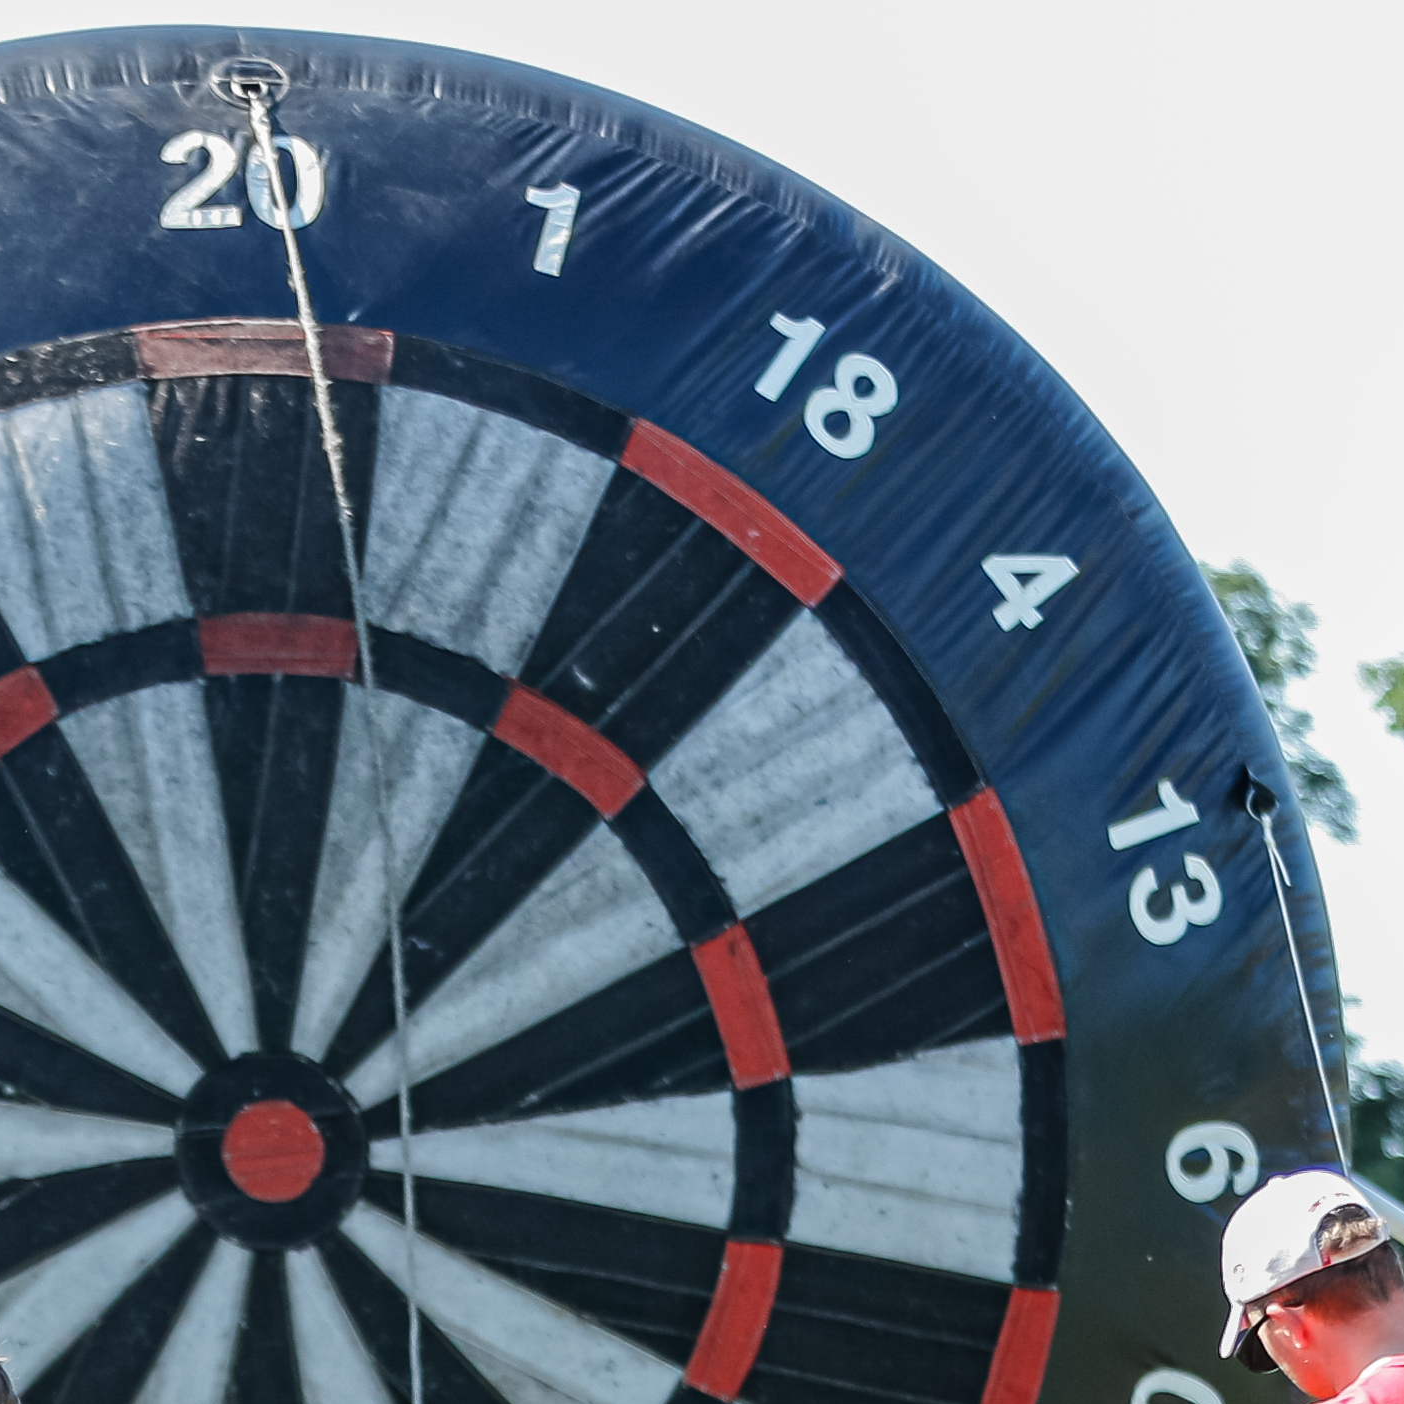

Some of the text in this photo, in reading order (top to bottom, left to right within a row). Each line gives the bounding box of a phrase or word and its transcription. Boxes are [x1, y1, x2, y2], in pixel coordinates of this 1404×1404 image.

[160, 131, 327, 231] 20
[524, 181, 582, 278] 1
[753, 311, 899, 460] 18
[980, 553, 1081, 633] 4
[1106, 778, 1224, 946] 13
[1164, 1120, 1261, 1204] 6
